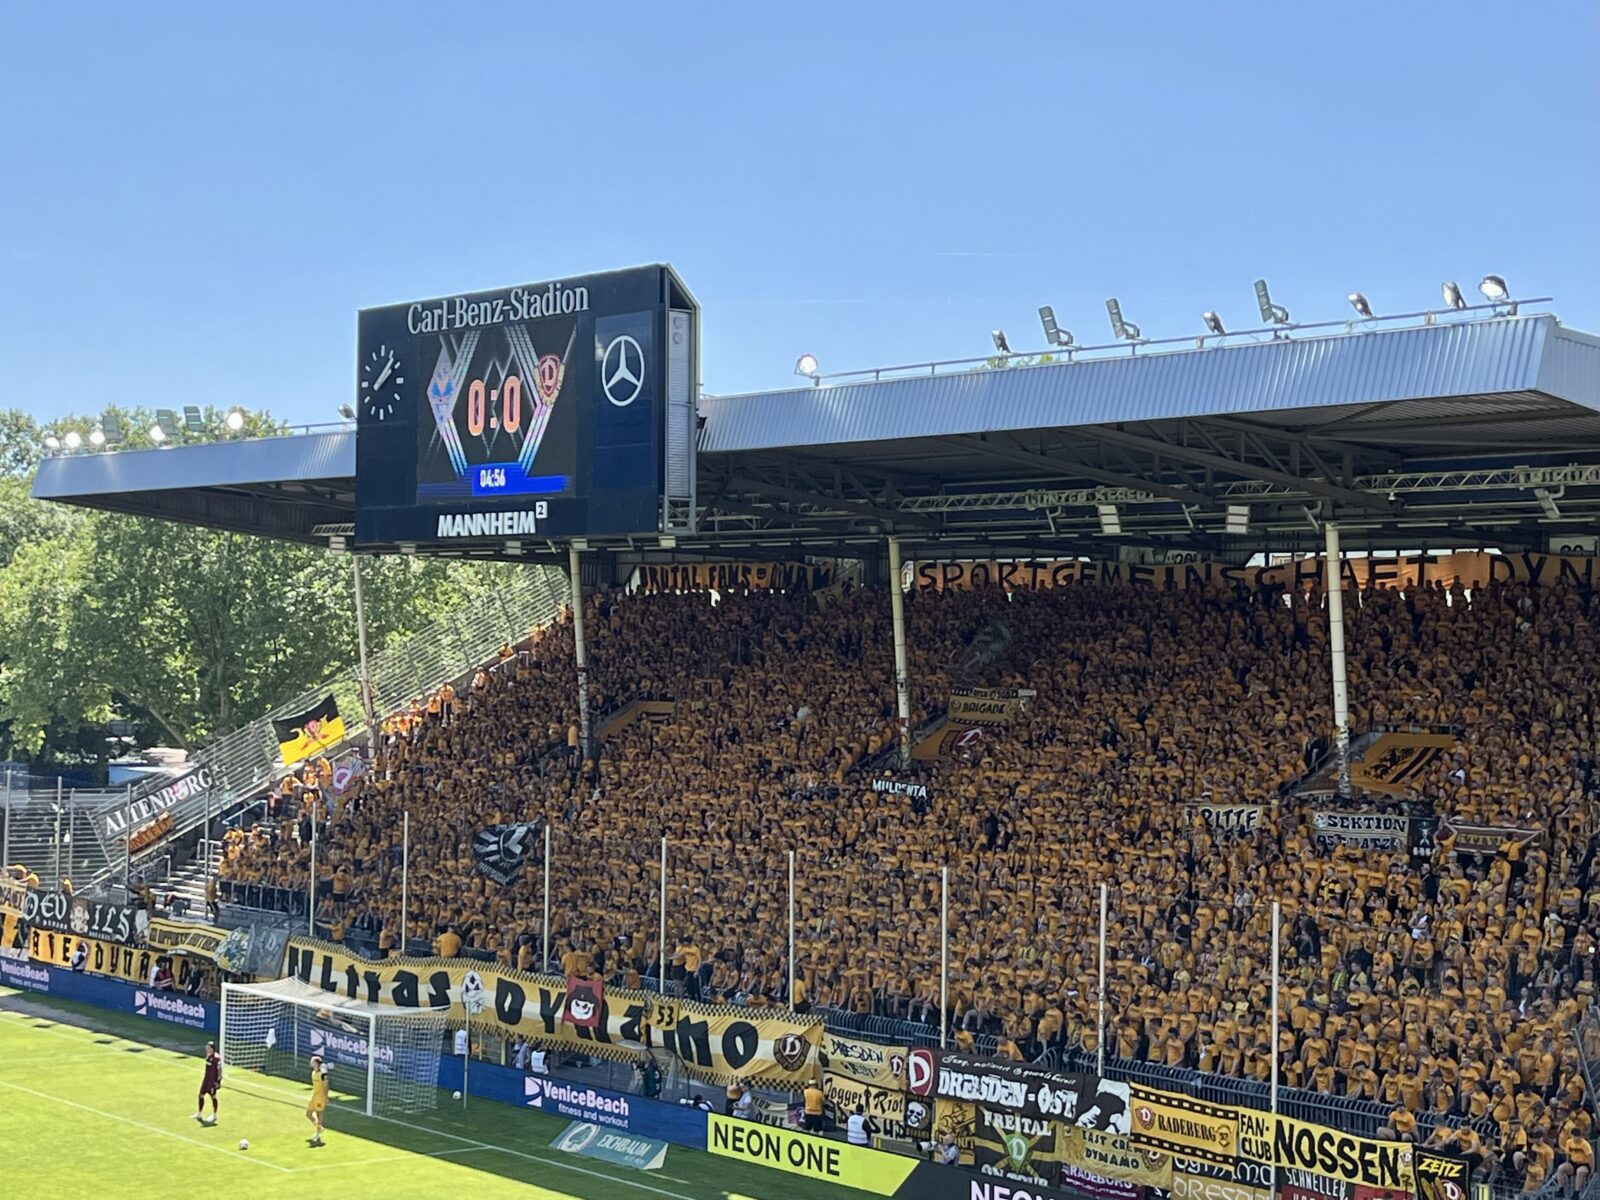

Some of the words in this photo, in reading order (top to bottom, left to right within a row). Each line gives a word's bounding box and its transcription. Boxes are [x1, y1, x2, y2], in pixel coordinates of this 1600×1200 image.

[407, 282, 590, 335] Carl-Benz-Stadion
[437, 511, 536, 537] MANNHEIM
[962, 702, 1006, 714] BRIGADE
[1327, 814, 1407, 833] SEKTION
[148, 992, 205, 1019] VeniceBeach
[657, 1005, 674, 1027] 53
[543, 1080, 629, 1116] VeniceBeach
[558, 1103, 582, 1117] fitness
[583, 1110, 597, 1121] and
[598, 1114, 629, 1129] workout
[983, 1109, 1052, 1137] FREITAL
[1158, 1115, 1216, 1142] RADEBERG
[714, 1121, 780, 1162] NEON
[787, 1138, 840, 1176] ONE
[1085, 1147, 1140, 1169] DYNAMO
[1240, 1137, 1272, 1161] CLUB
[1274, 1119, 1401, 1188] NOSSEN
[1418, 1158, 1463, 1177] ZEITZ
[1285, 1167, 1346, 1200] SCHNELLER
